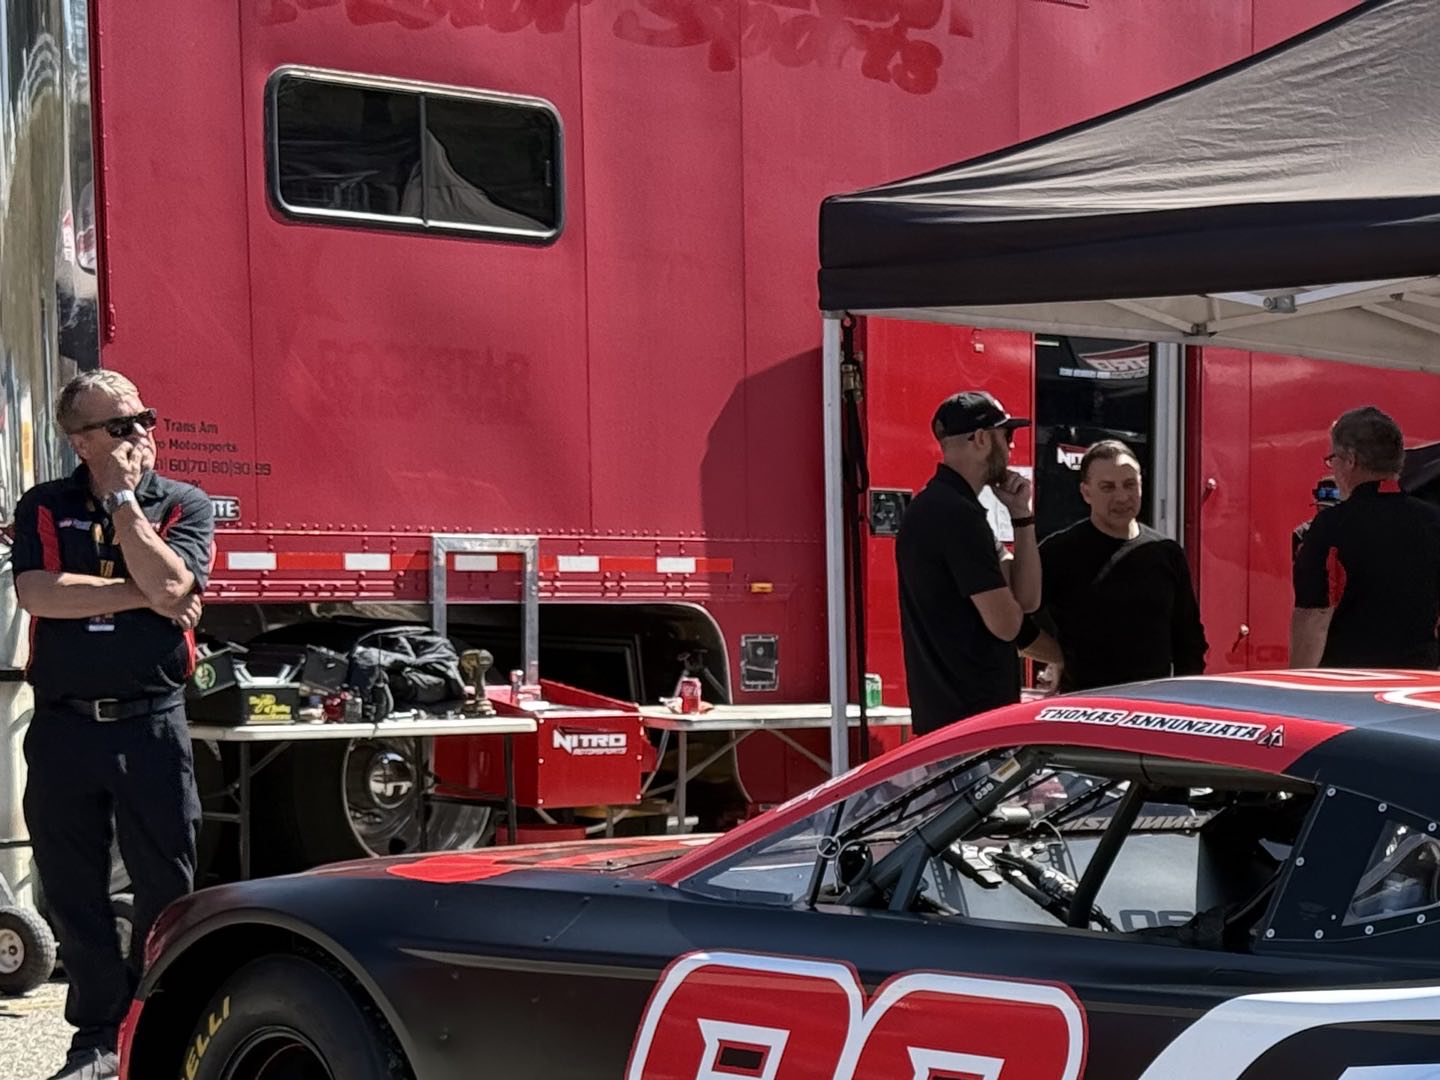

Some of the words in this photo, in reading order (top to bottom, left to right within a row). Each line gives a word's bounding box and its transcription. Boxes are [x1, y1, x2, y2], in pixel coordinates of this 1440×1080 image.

[163, 419, 196, 433] Trans
[198, 421, 218, 434] Am
[169, 440, 238, 453] Motorsports
[1042, 708, 1120, 723] THOMAS
[1123, 714, 1260, 739] ANNUNZIATA
[553, 728, 628, 754] NITRO
